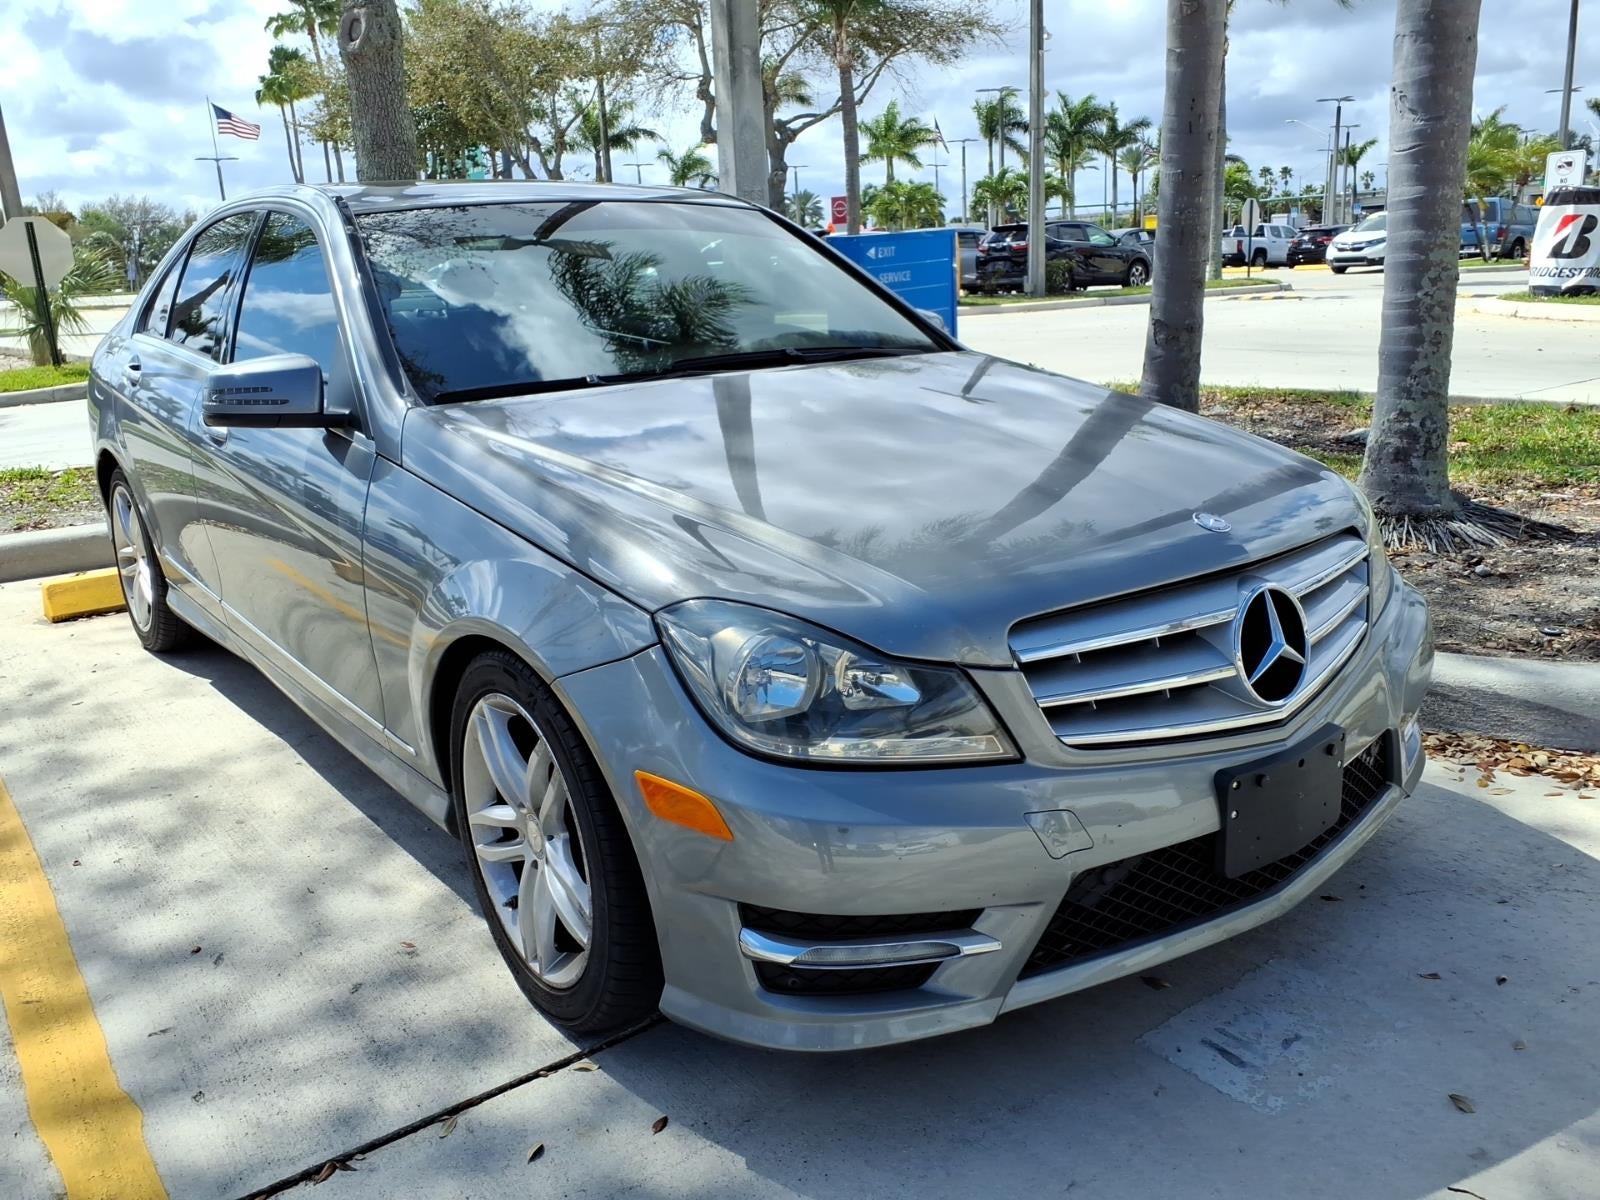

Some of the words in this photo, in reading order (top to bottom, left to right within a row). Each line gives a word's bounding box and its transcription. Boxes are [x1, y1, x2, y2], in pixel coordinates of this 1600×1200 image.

[878, 246, 896, 258] EXIT
[879, 270, 912, 283] SERVICE
[1529, 266, 1600, 279] RIDGESTON
